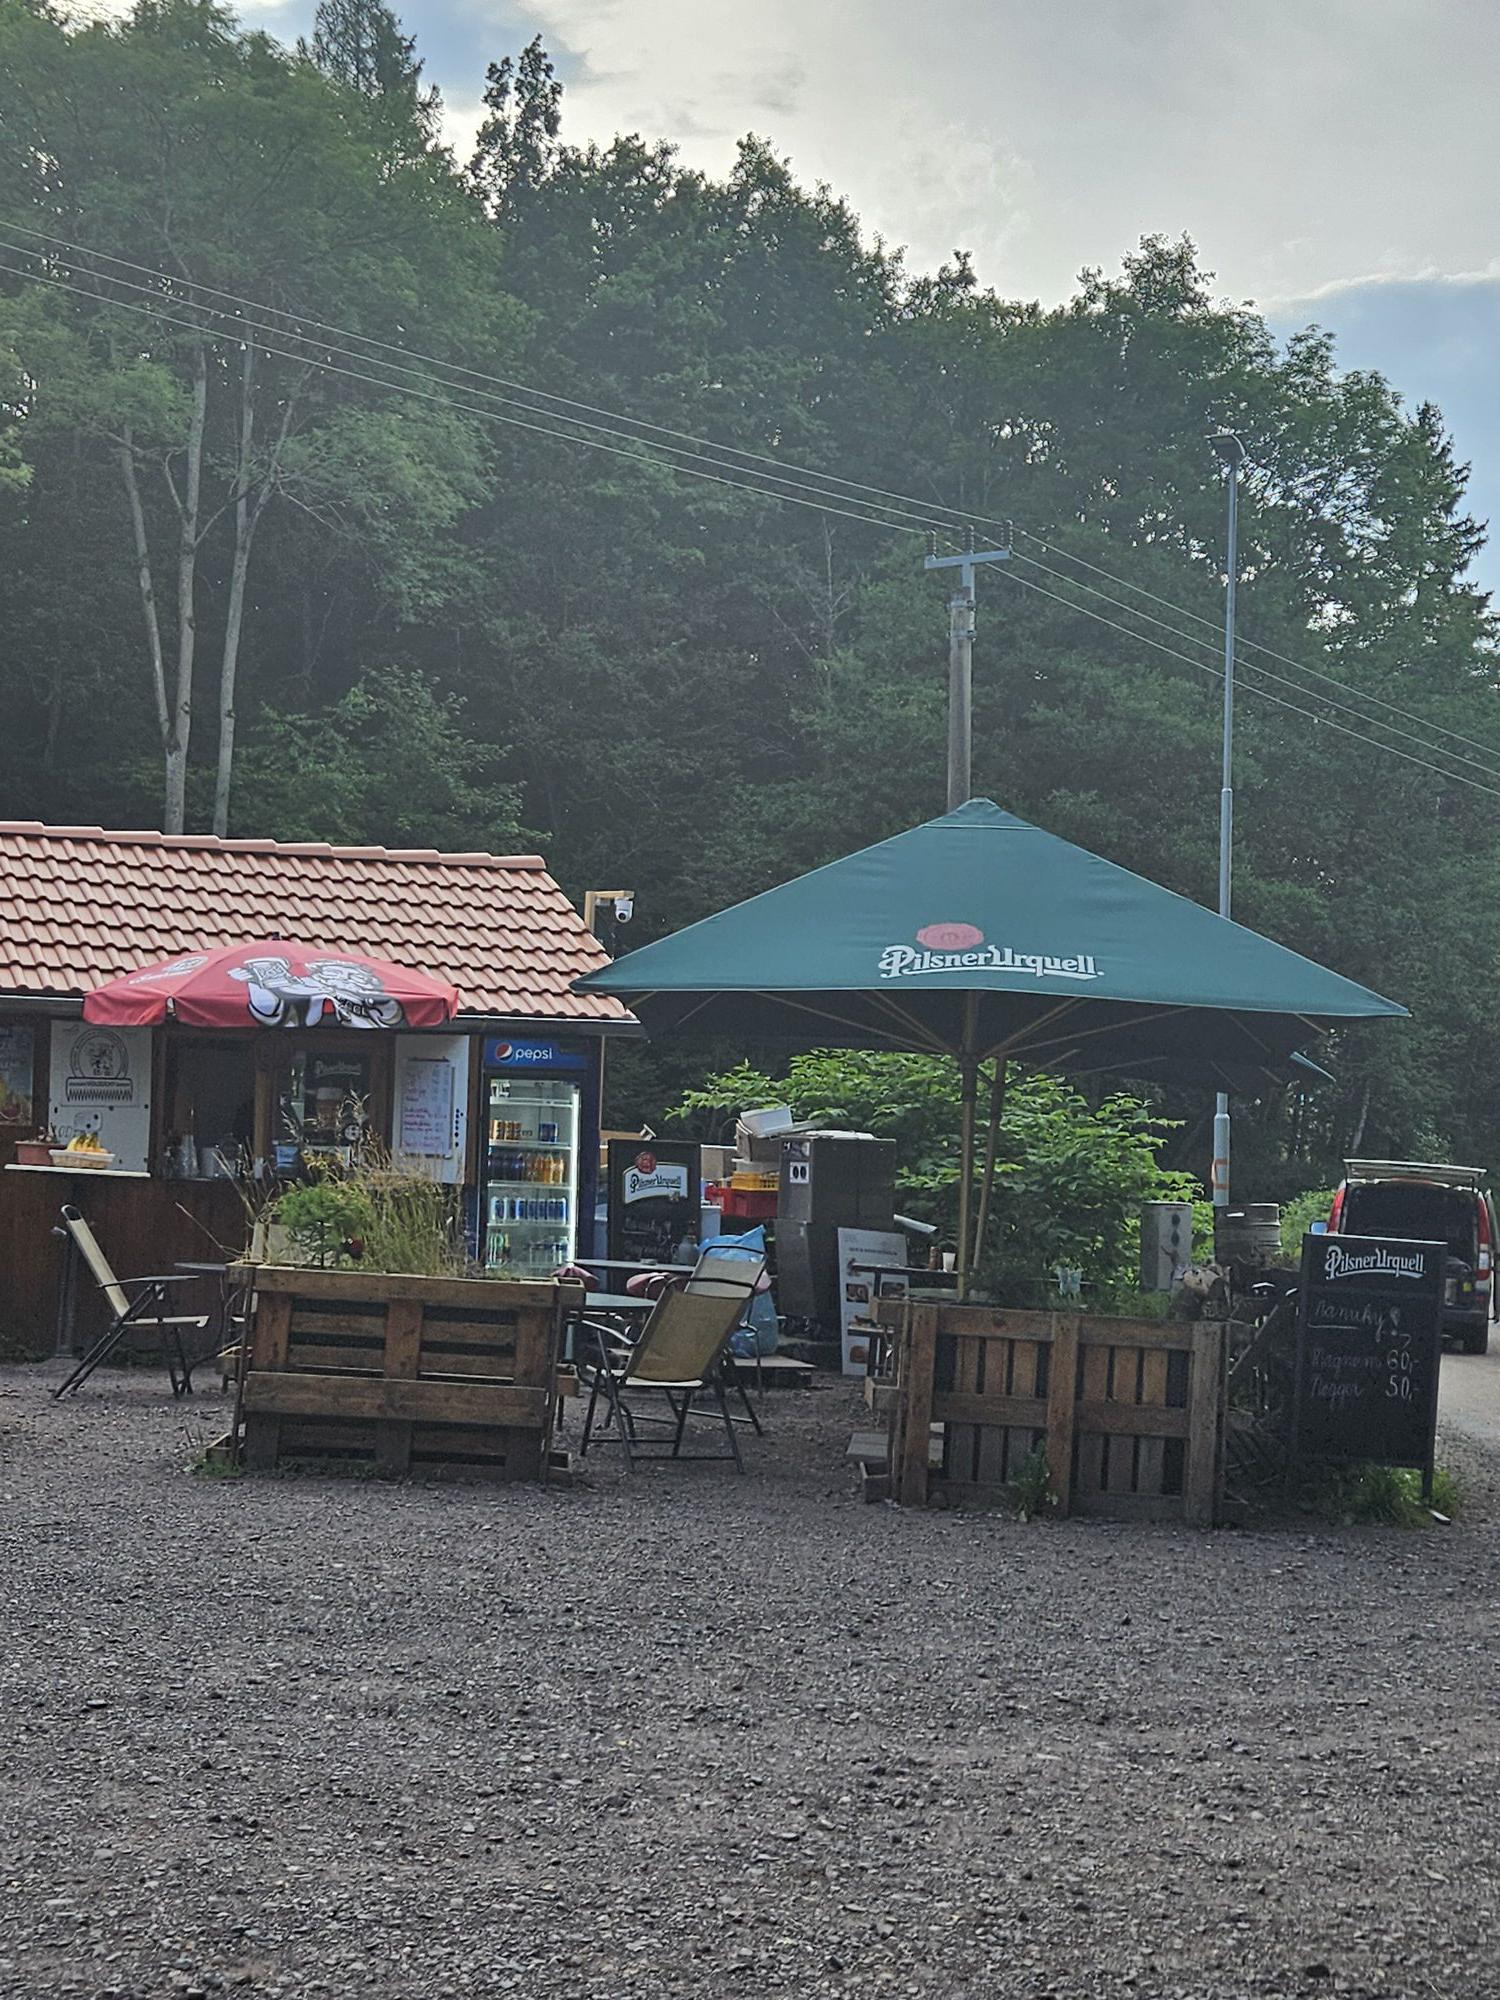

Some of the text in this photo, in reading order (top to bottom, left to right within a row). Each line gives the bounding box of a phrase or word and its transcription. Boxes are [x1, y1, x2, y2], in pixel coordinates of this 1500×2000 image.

[878, 944, 1096, 978] Pilsner Urquell
[515, 1047, 553, 1061] pepsi
[629, 1174, 656, 1193] Pilsner
[1324, 1245, 1424, 1280] Pilsner Urquell
